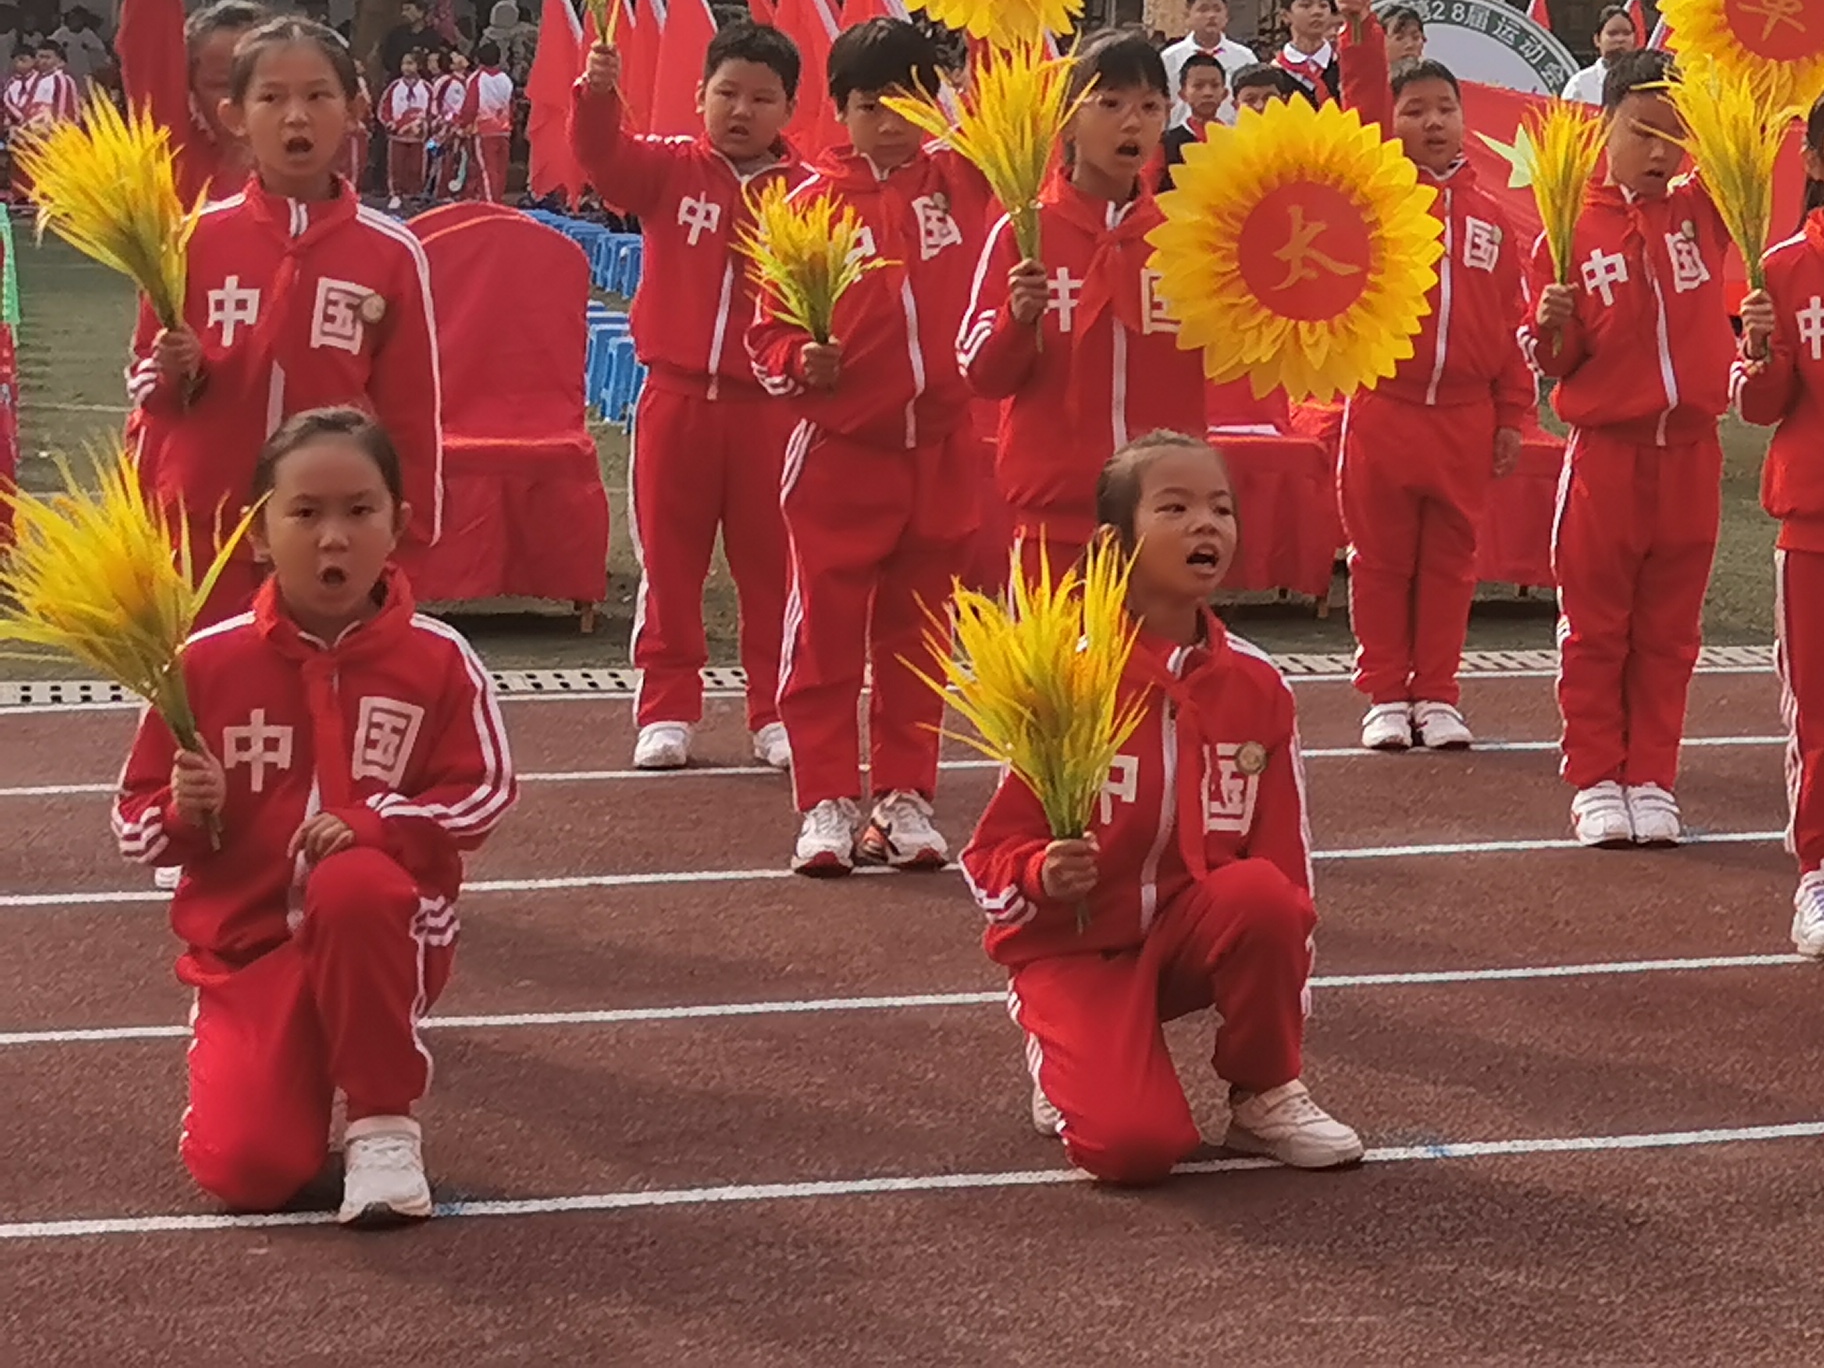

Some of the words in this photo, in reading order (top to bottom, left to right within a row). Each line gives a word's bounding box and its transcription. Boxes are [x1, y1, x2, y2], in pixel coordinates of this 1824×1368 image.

[1271, 205, 1363, 292] 太
[207, 275, 376, 355] 中国
[223, 695, 424, 792] 中国
